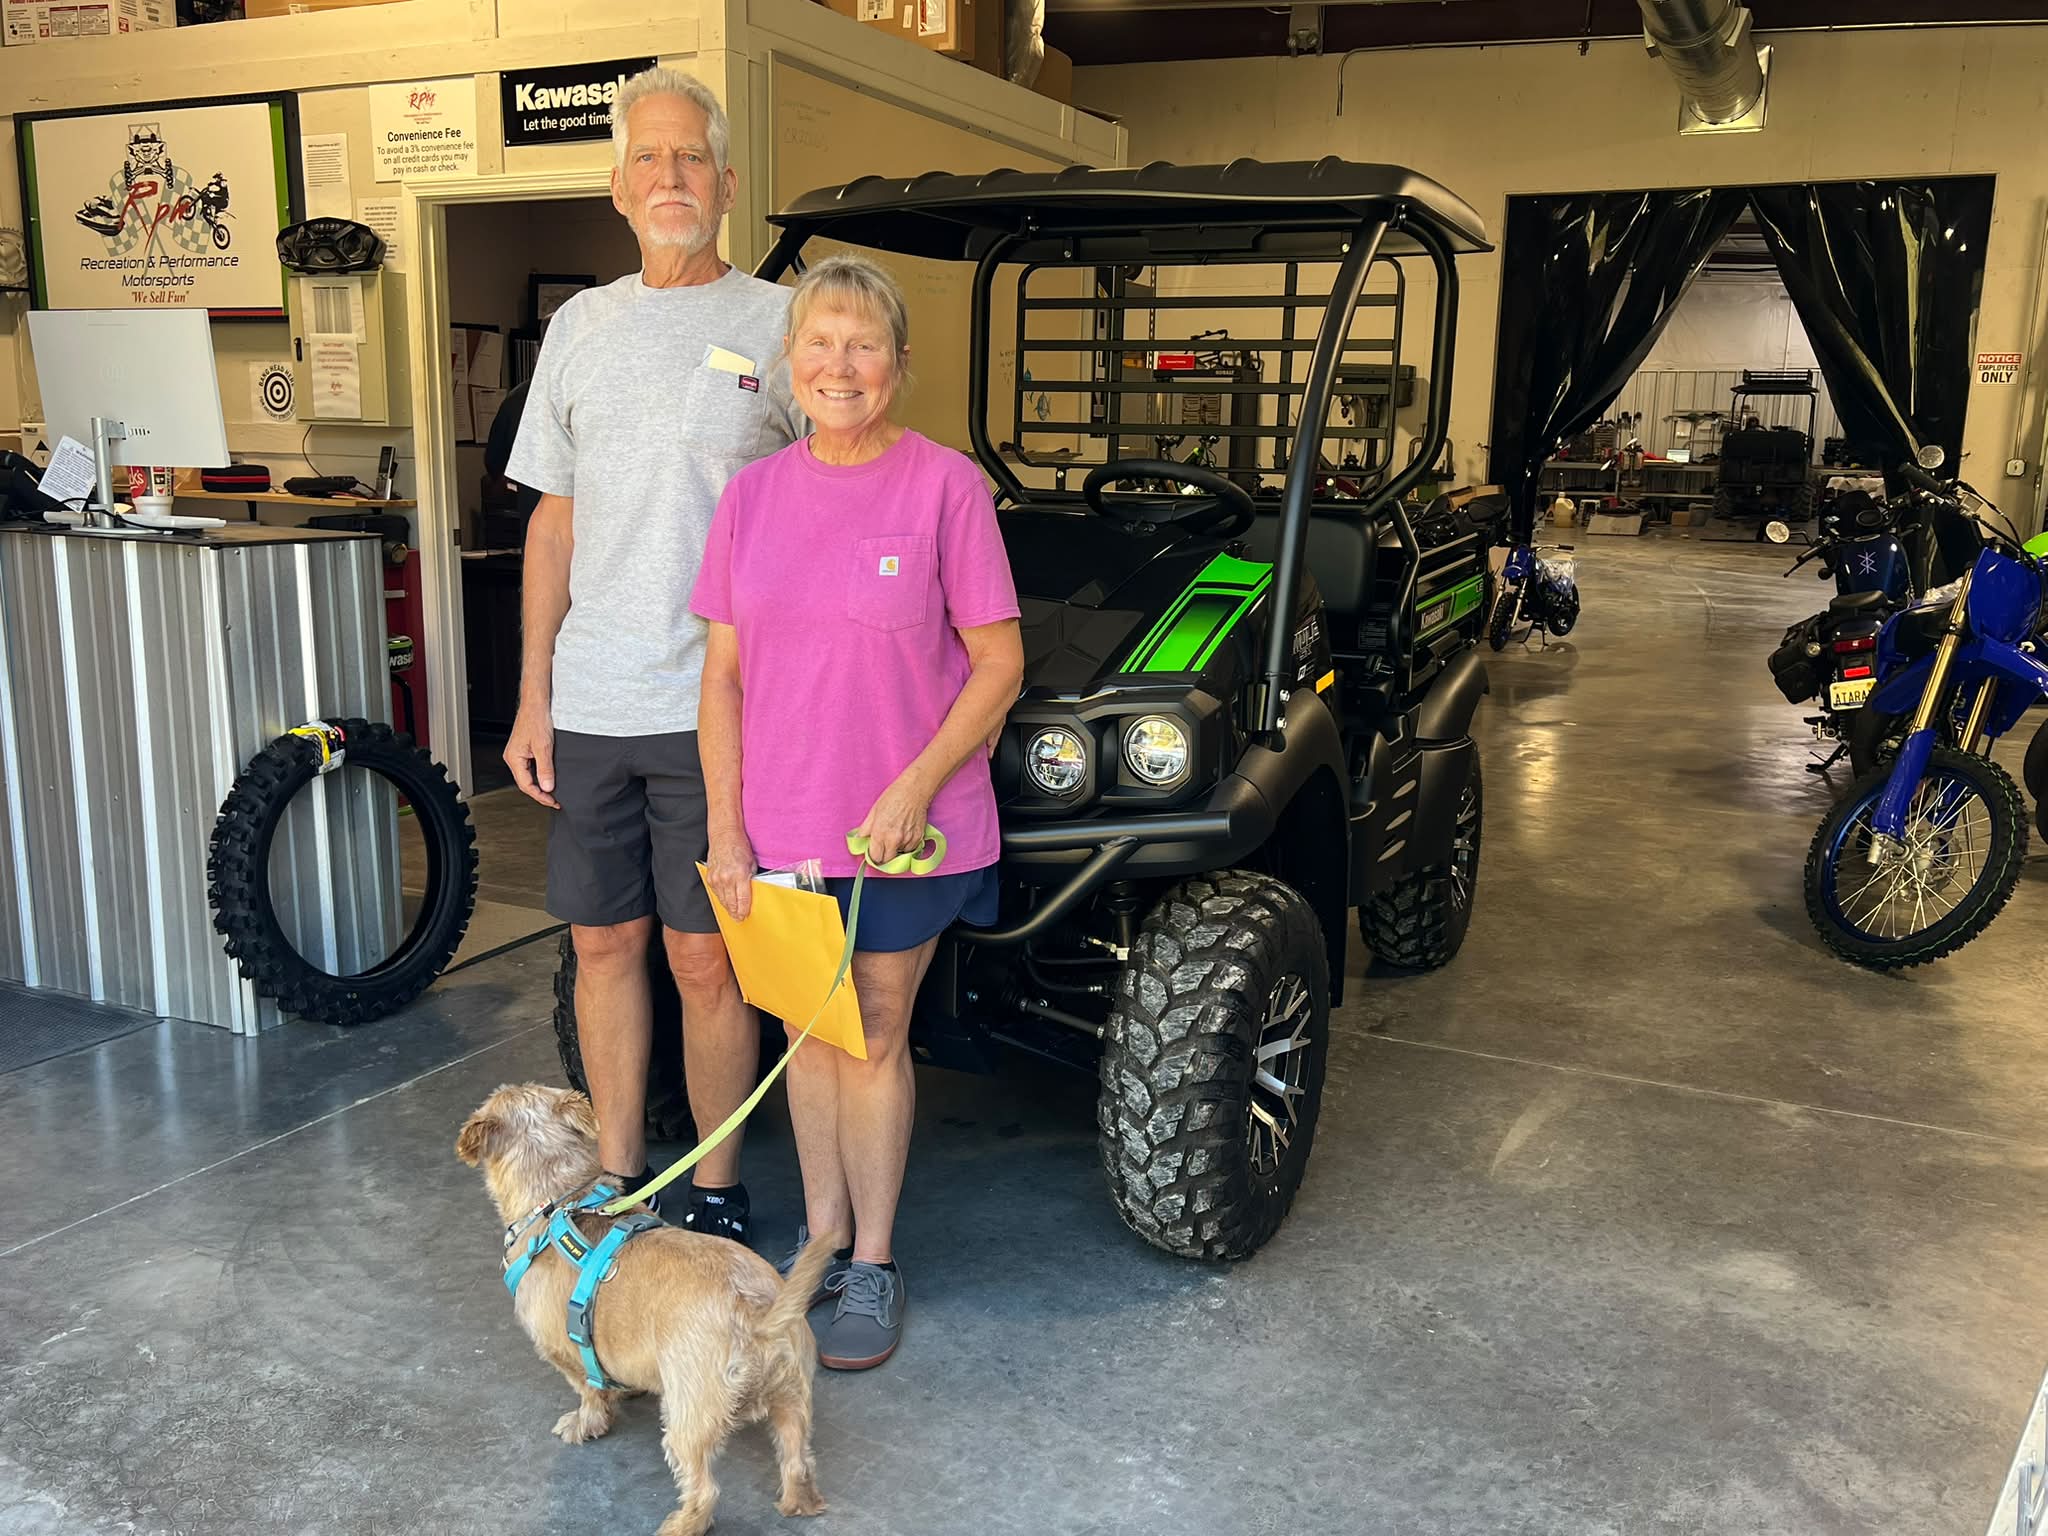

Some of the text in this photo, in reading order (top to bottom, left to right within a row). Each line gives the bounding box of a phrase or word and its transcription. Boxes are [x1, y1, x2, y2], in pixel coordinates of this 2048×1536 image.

[515, 73, 640, 112] Kawasa
[523, 118, 539, 131] Let
[541, 116, 557, 129] the
[559, 113, 586, 131] good
[387, 127, 462, 142] Convenience Fee
[377, 146, 385, 155] To
[386, 145, 404, 154] avoid
[410, 144, 420, 153] 3%
[421, 143, 461, 152] convenience
[463, 141, 474, 150] fee
[393, 155, 401, 164] all
[402, 155, 420, 163] credit
[421, 153, 440, 163] cards
[440, 154, 453, 164] you
[453, 153, 468, 163] may
[393, 166, 404, 176] pay
[405, 165, 412, 173] in
[413, 164, 428, 173] cash
[80, 254, 239, 270] Recreation & Performance
[121, 274, 195, 288] Motorsports
[149, 291, 165, 303] Sell
[1979, 355, 2021, 363] NOTICE
[1981, 371, 2013, 383] ONLY
[1835, 688, 1870, 705] ATARA
[706, 1195, 725, 1205] XERO
